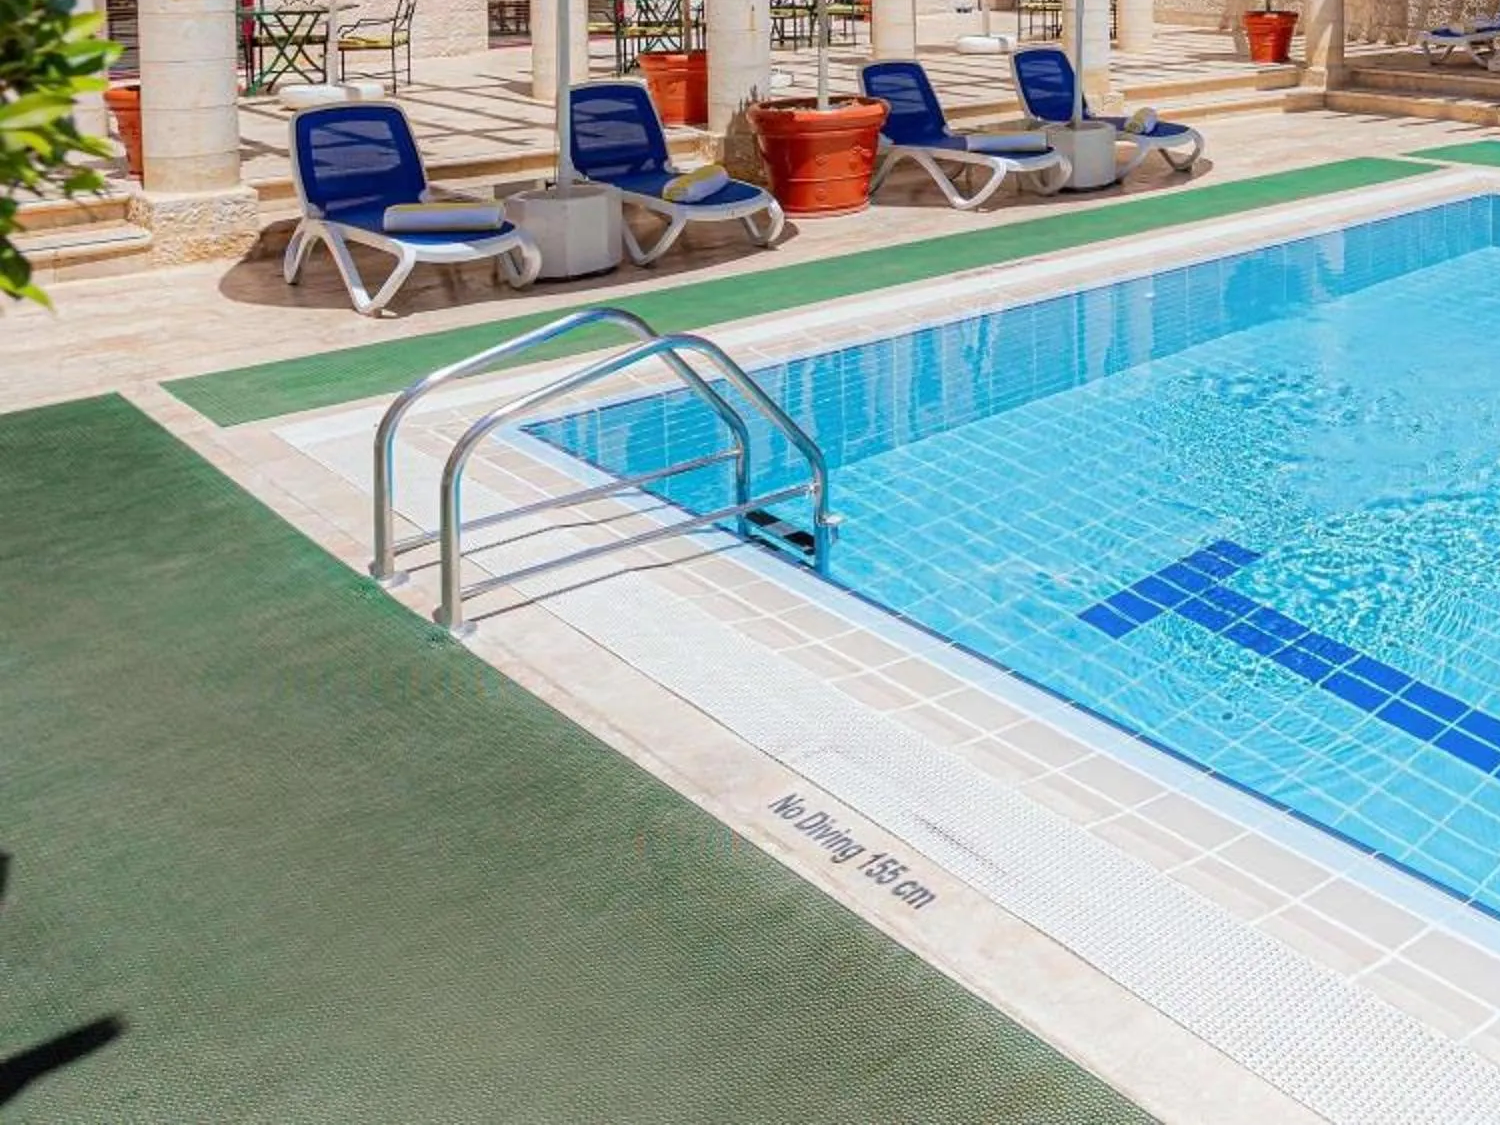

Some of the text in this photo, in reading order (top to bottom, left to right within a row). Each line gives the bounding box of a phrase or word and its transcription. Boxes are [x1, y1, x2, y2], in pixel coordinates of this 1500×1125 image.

[767, 793, 936, 910] No Diving 155 cm
